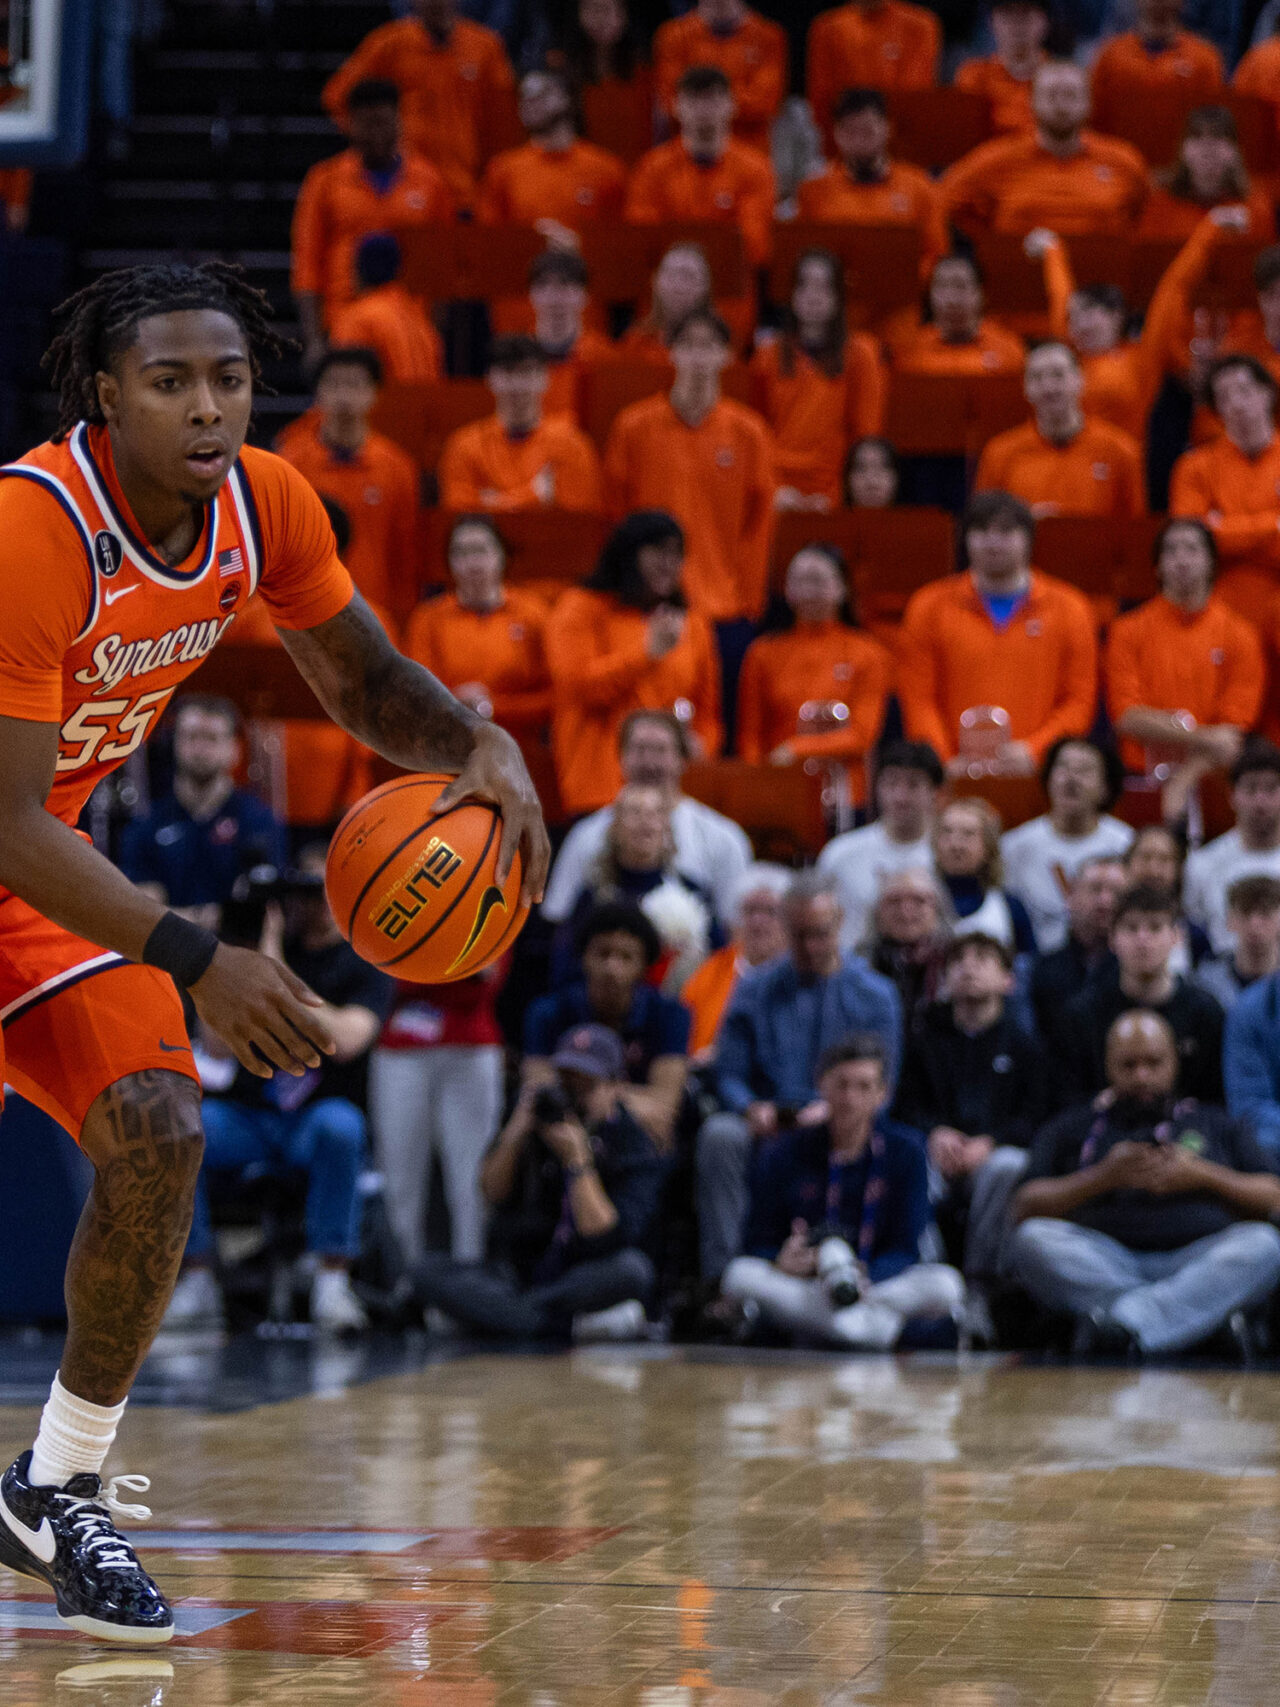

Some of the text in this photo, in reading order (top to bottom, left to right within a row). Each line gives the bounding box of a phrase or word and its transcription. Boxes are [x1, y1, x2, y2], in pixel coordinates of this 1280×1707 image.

[104, 551, 114, 573] 21
[56, 685, 176, 771] 55
[373, 840, 464, 941] ELITE
